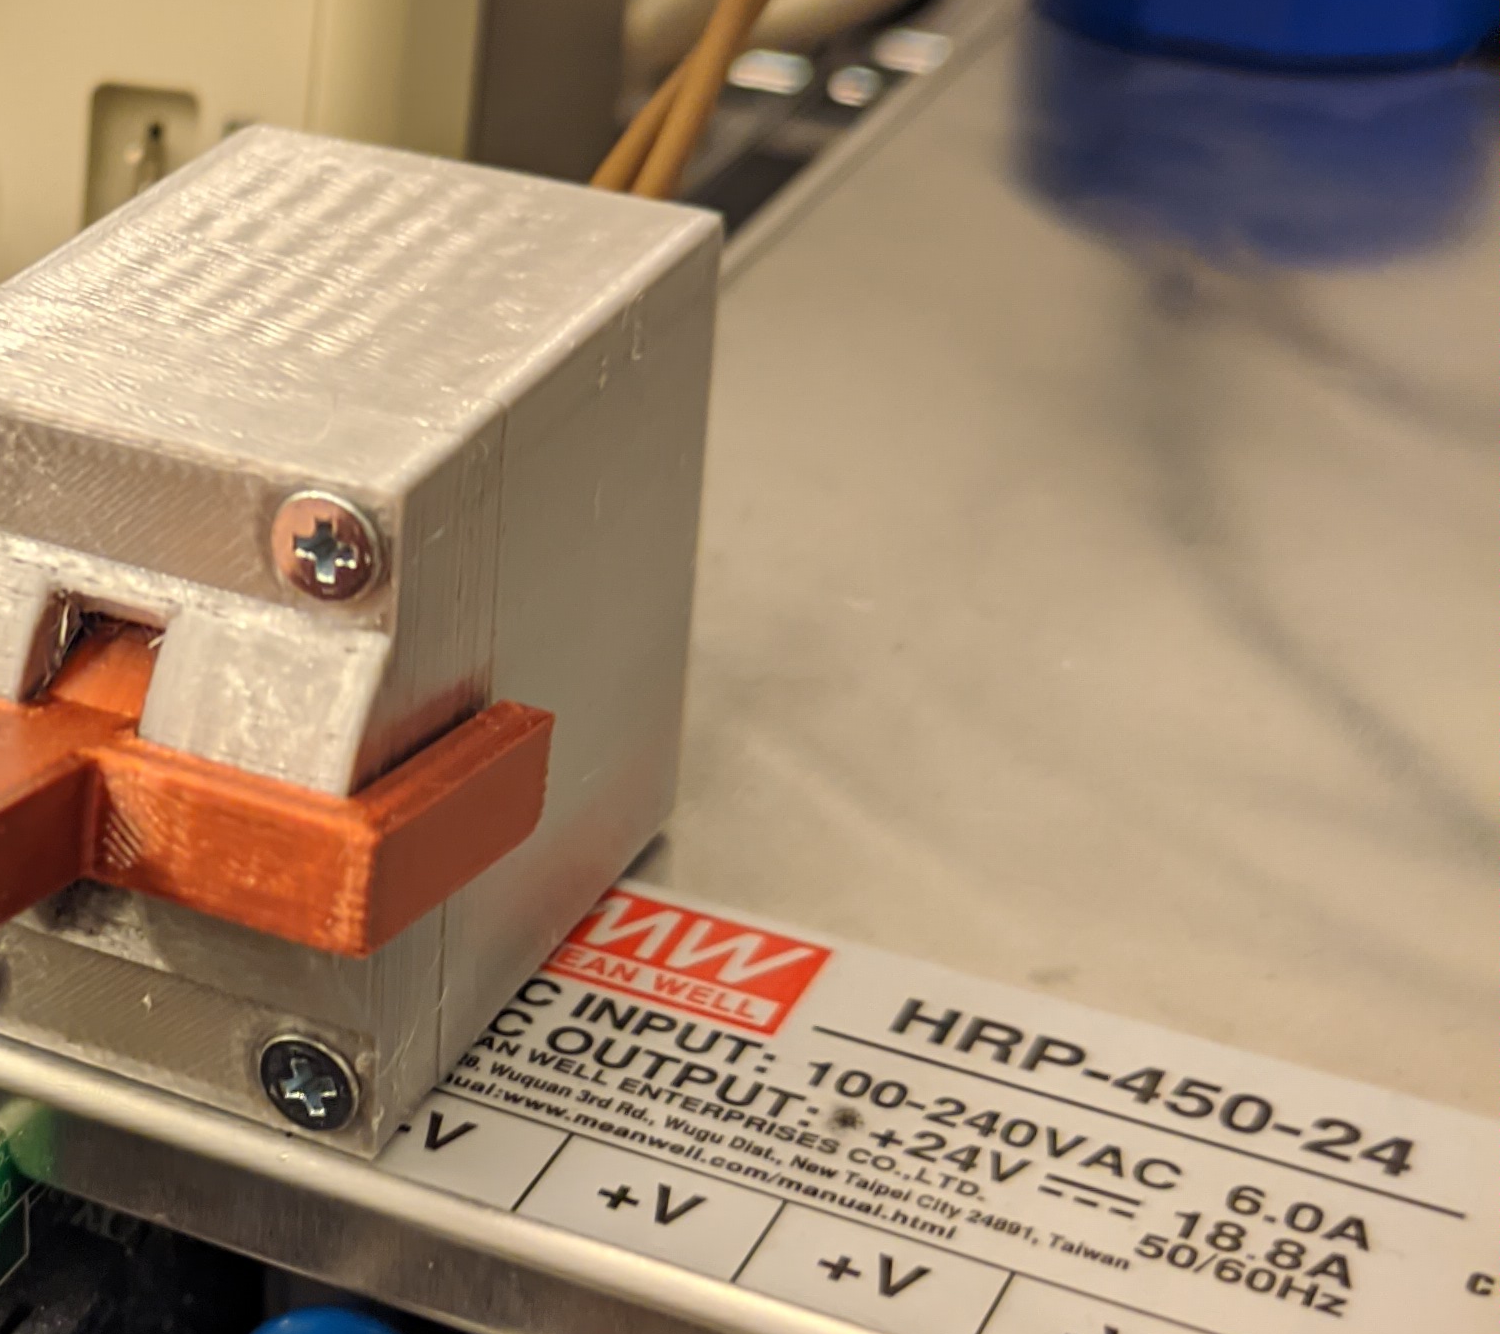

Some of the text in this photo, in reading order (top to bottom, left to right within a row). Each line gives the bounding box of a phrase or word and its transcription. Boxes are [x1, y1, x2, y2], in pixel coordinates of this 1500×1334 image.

[555, 947, 757, 1019] EAN WELL
[528, 1049, 607, 1085] WELL
[617, 1077, 841, 1154] ENTERPRISES
[570, 992, 776, 1073] INPUT:
[808, 1061, 1183, 1189] 100-240VAC
[1226, 1185, 1369, 1251] 6.0A
[888, 996, 1418, 1178] HRP-450-24
[490, 1061, 571, 1098] Wuquan
[576, 1088, 613, 1110] 3rd
[665, 1115, 724, 1145] Wugu
[790, 1155, 839, 1179] New
[844, 1170, 912, 1202] Taipei
[916, 1193, 962, 1219] City
[1049, 1233, 1130, 1271] Taiwan
[546, 1026, 819, 1127] OUTPUT:
[869, 1129, 1032, 1183] +24V
[1175, 1211, 1352, 1289] 18.8A
[598, 1184, 707, 1226] +V
[819, 1253, 930, 1298] +V
[1134, 1233, 1348, 1318] 50/60Hz
